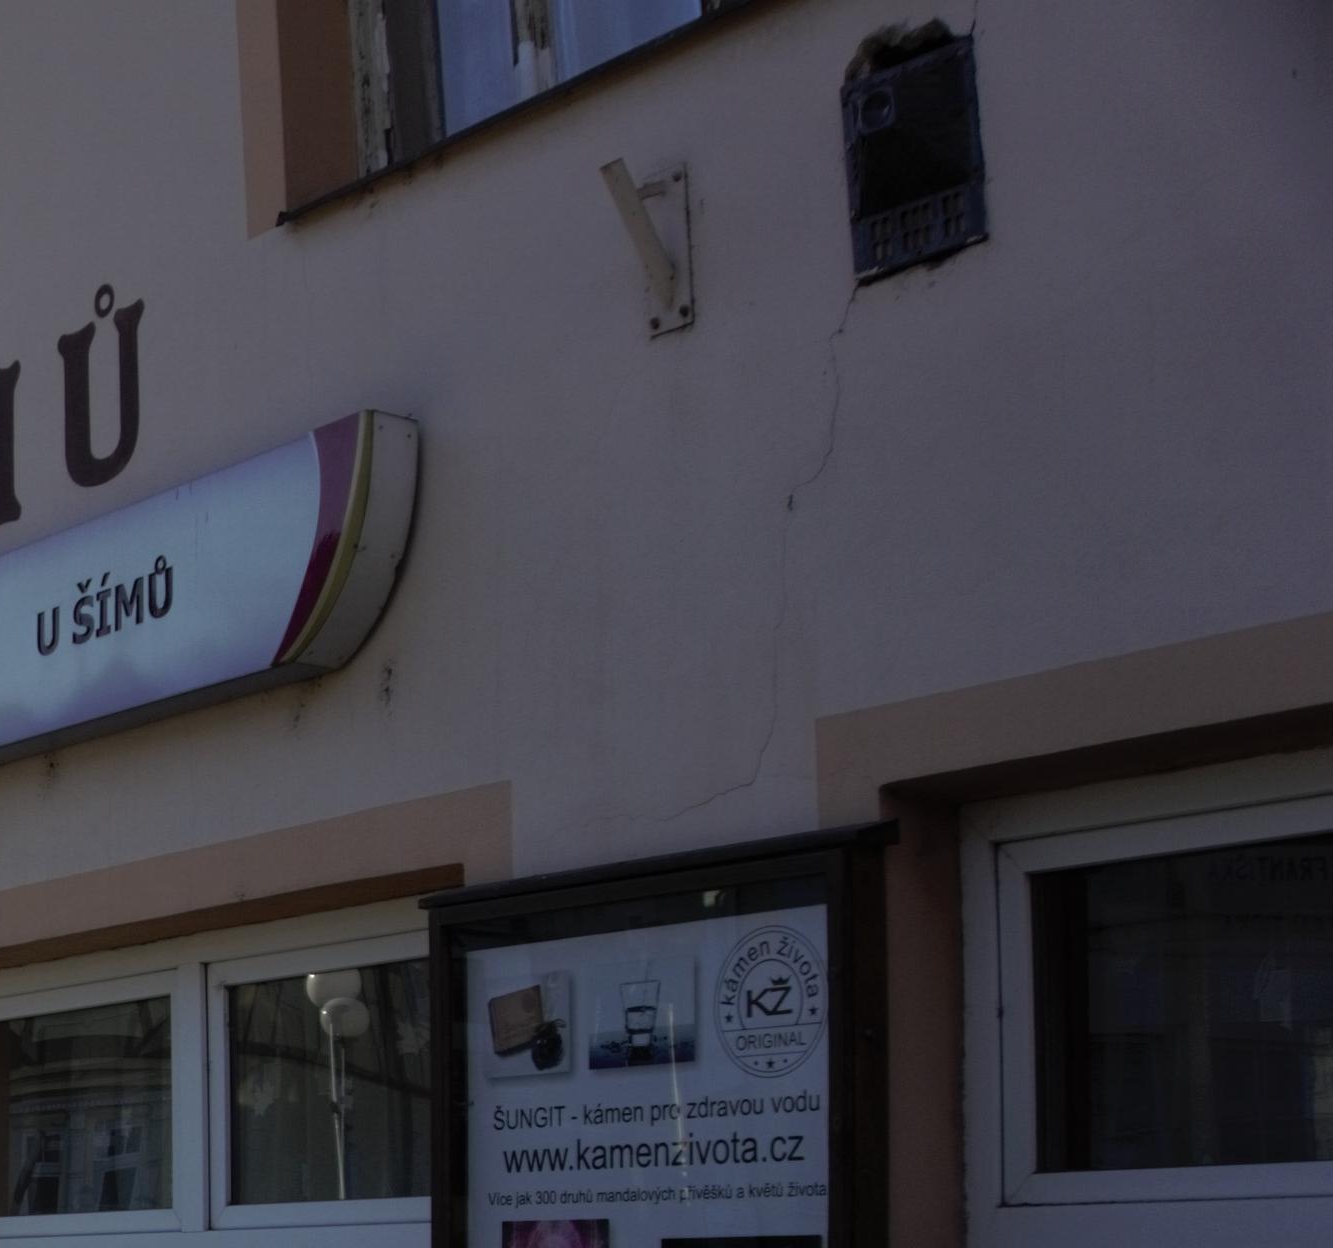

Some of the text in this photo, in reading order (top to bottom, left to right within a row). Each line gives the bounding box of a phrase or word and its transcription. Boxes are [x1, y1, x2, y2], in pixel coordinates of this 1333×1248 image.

[36, 555, 175, 657] U ŠÍMŮ
[721, 936, 820, 1005] kámen života
[736, 1032, 807, 1051] ORIGINAL
[493, 1105, 565, 1131] ŠUNGIT
[583, 1103, 644, 1125] kámen
[651, 1103, 680, 1126] pro
[686, 1096, 764, 1119] zdravou
[772, 1089, 821, 1113] vodu
[503, 1131, 805, 1173] www.kamenzivota.cz
[488, 1192, 512, 1206] Více
[515, 1191, 532, 1208] jak
[535, 1190, 556, 1205] 300
[597, 1186, 675, 1205] mandalových
[736, 1186, 745, 1199] a
[788, 1181, 827, 1198] života
